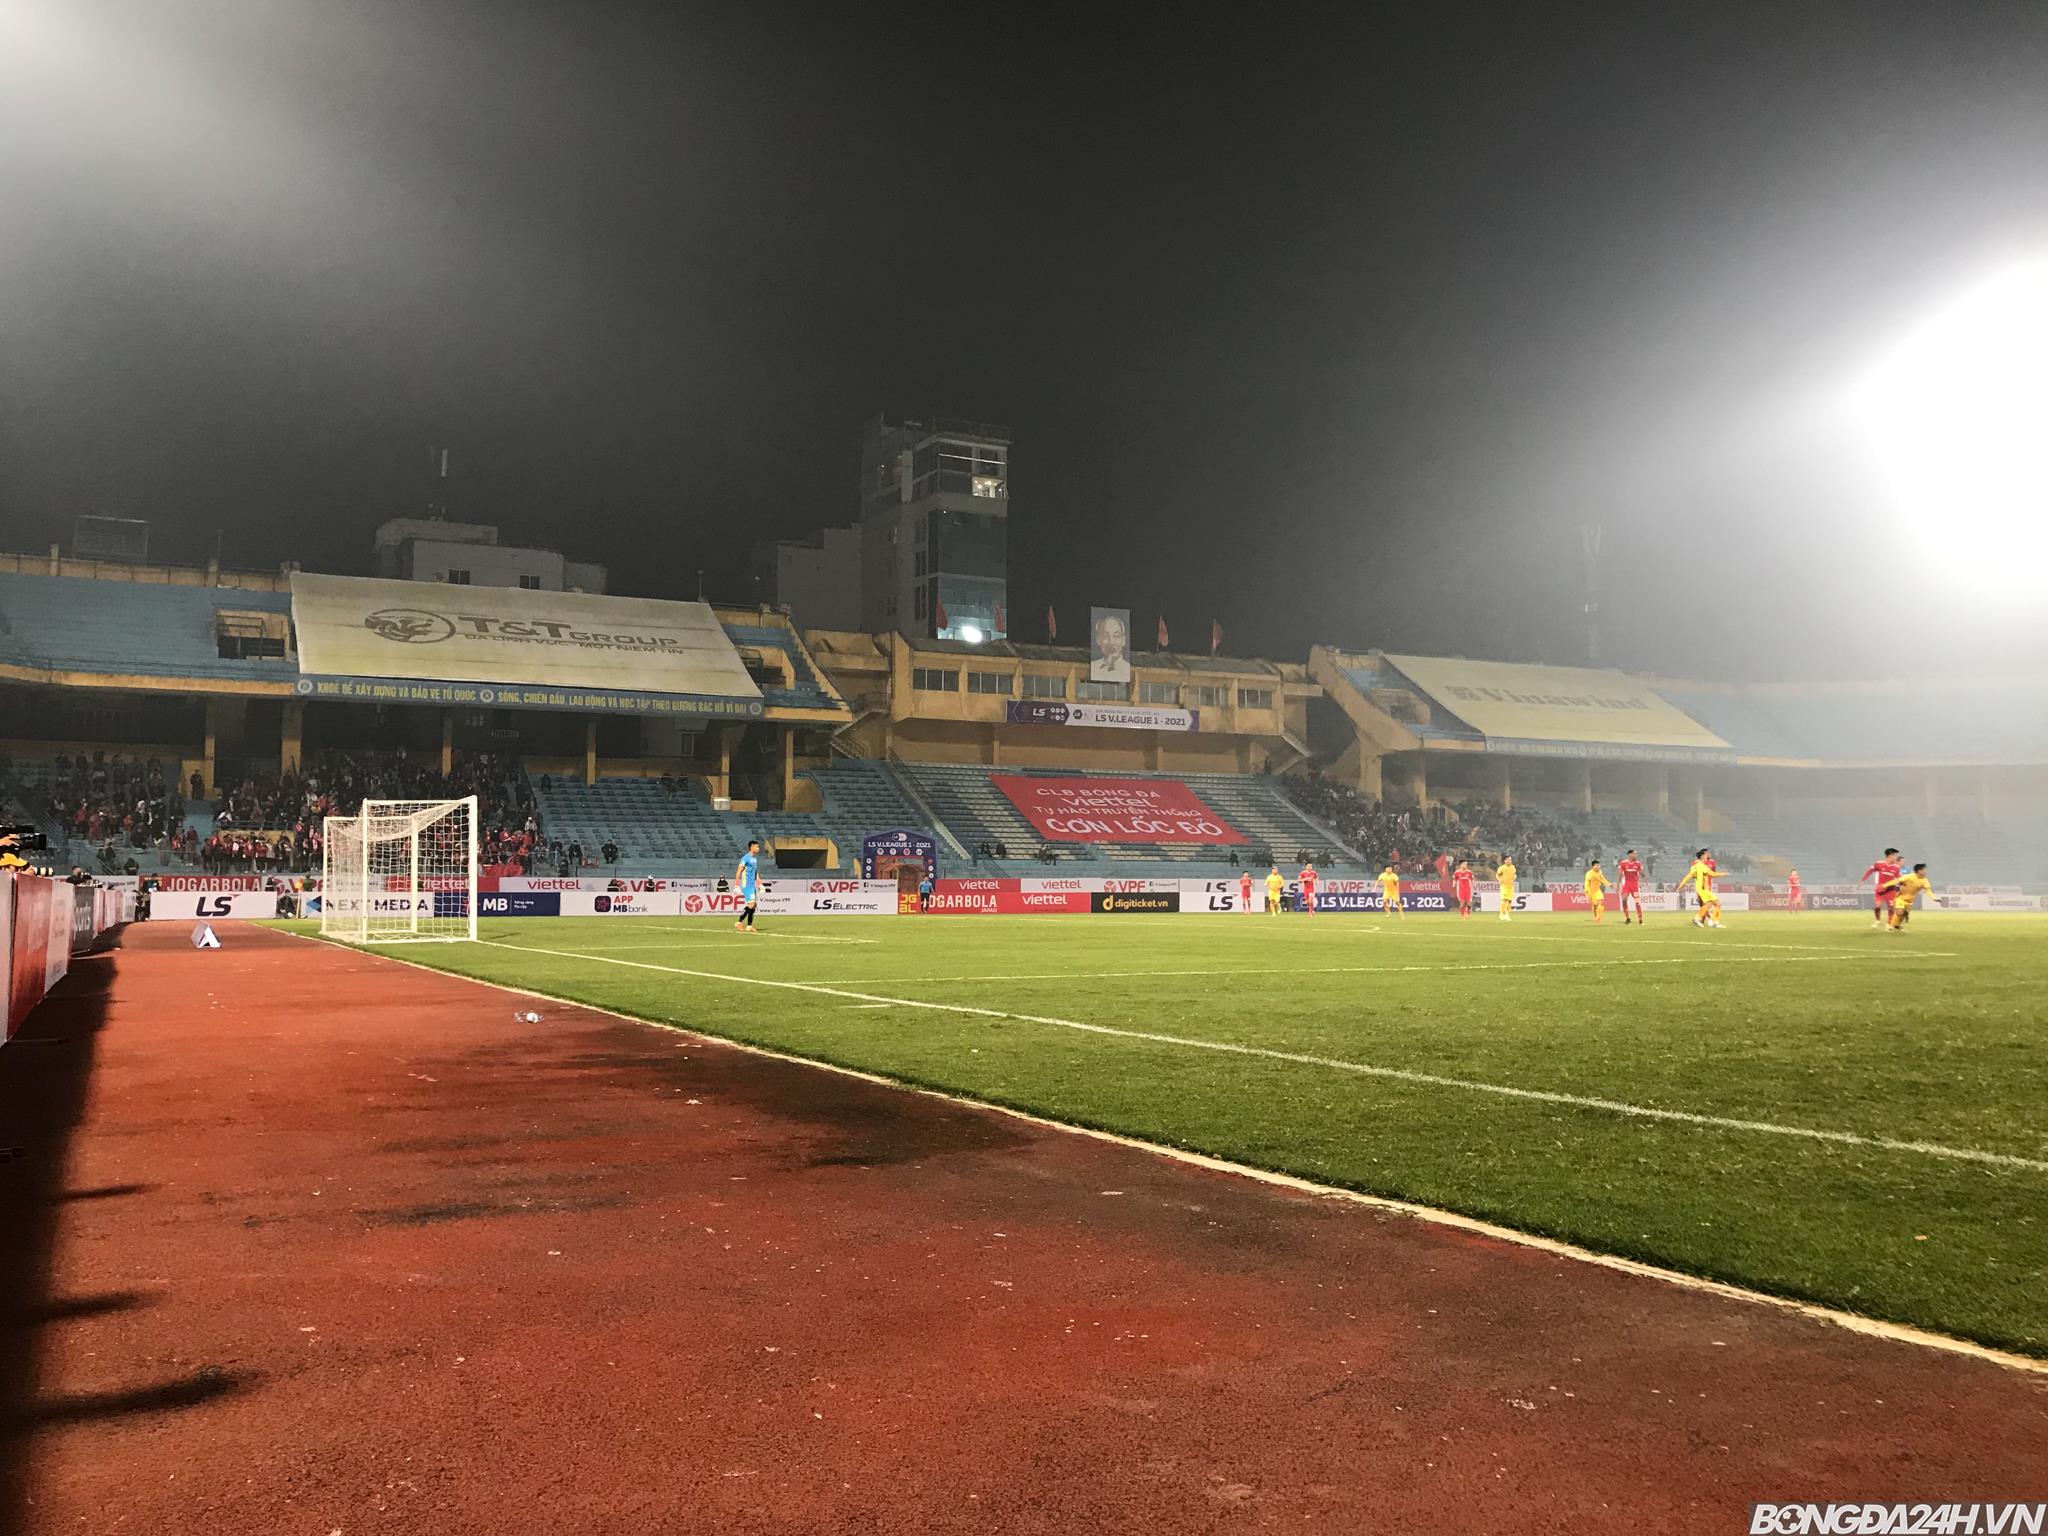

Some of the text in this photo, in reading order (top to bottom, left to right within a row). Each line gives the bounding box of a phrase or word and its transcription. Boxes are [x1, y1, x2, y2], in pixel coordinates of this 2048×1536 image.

[458, 616, 678, 646] T&T GROUP
[1032, 708, 1046, 717] LS
[1095, 714, 1107, 722] LS
[1109, 715, 1152, 724] V.LEAGUE
[1165, 718, 1186, 726] 2021
[1036, 788, 1074, 797] CLB
[166, 877, 262, 892] JOGARBOLA
[527, 879, 581, 890] viettel
[826, 881, 860, 893] VPF
[958, 880, 999, 890] viettel
[1041, 879, 1082, 889] viettel
[1118, 880, 1146, 892] VPF
[1340, 881, 1364, 892] VPF
[1410, 882, 1441, 891] viettel
[482, 898, 508, 911] MB
[706, 895, 745, 911] VPF
[813, 899, 832, 910] LS
[1022, 894, 1067, 905] viettel
[1115, 898, 1168, 909] digiticket.vn
[1209, 896, 1233, 910] LS
[1321, 896, 1336, 907] LS
[1417, 897, 1445, 908] 2021
[195, 896, 232, 917] LS
[613, 905, 648, 913] MB bank
